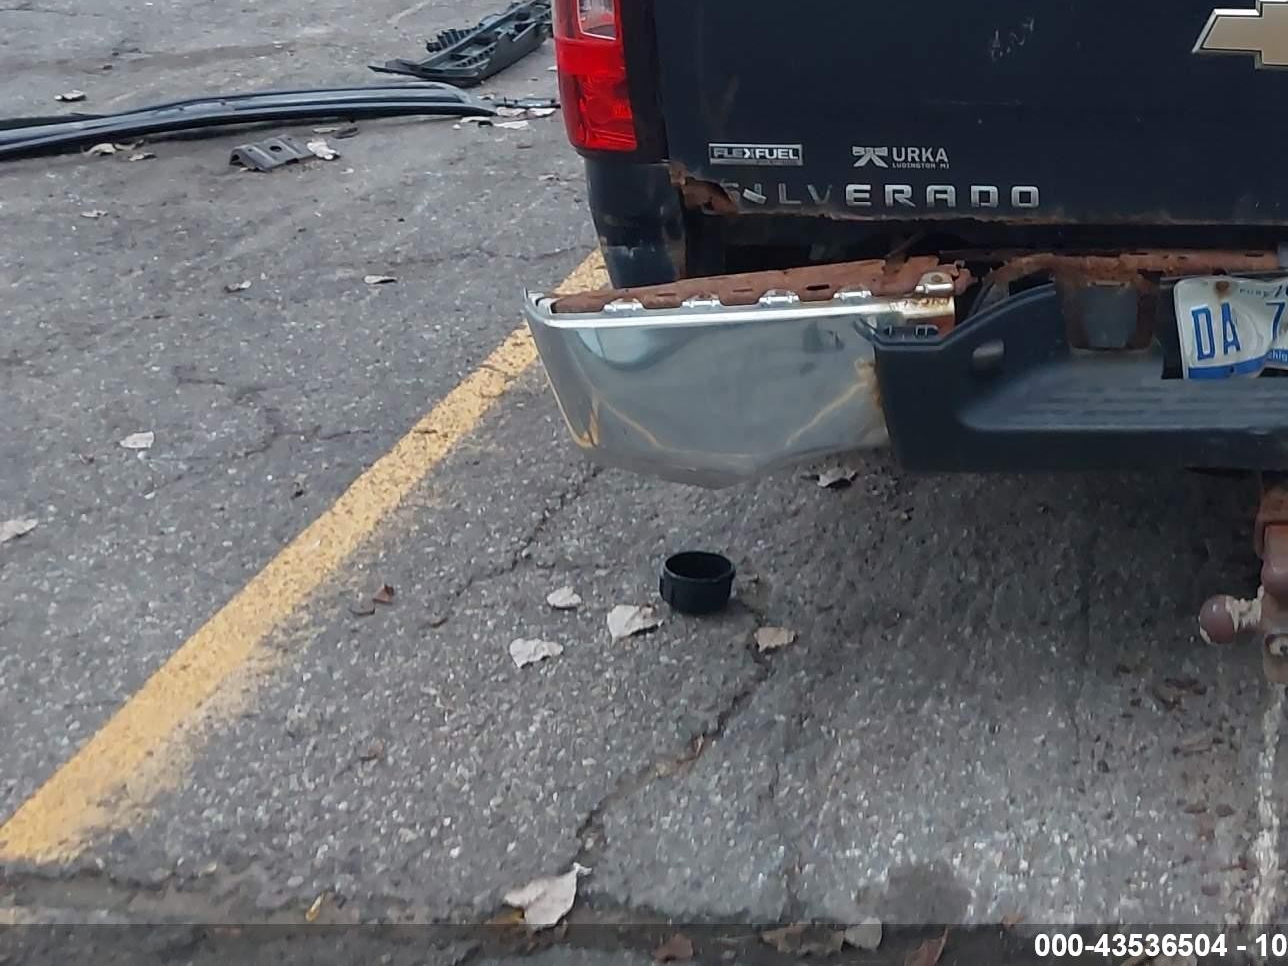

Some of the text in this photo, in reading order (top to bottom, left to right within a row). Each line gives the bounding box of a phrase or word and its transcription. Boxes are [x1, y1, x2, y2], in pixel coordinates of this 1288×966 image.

[713, 147, 799, 160] FLEXFUEL
[892, 146, 949, 163] URKA
[1191, 303, 1241, 361] DA
